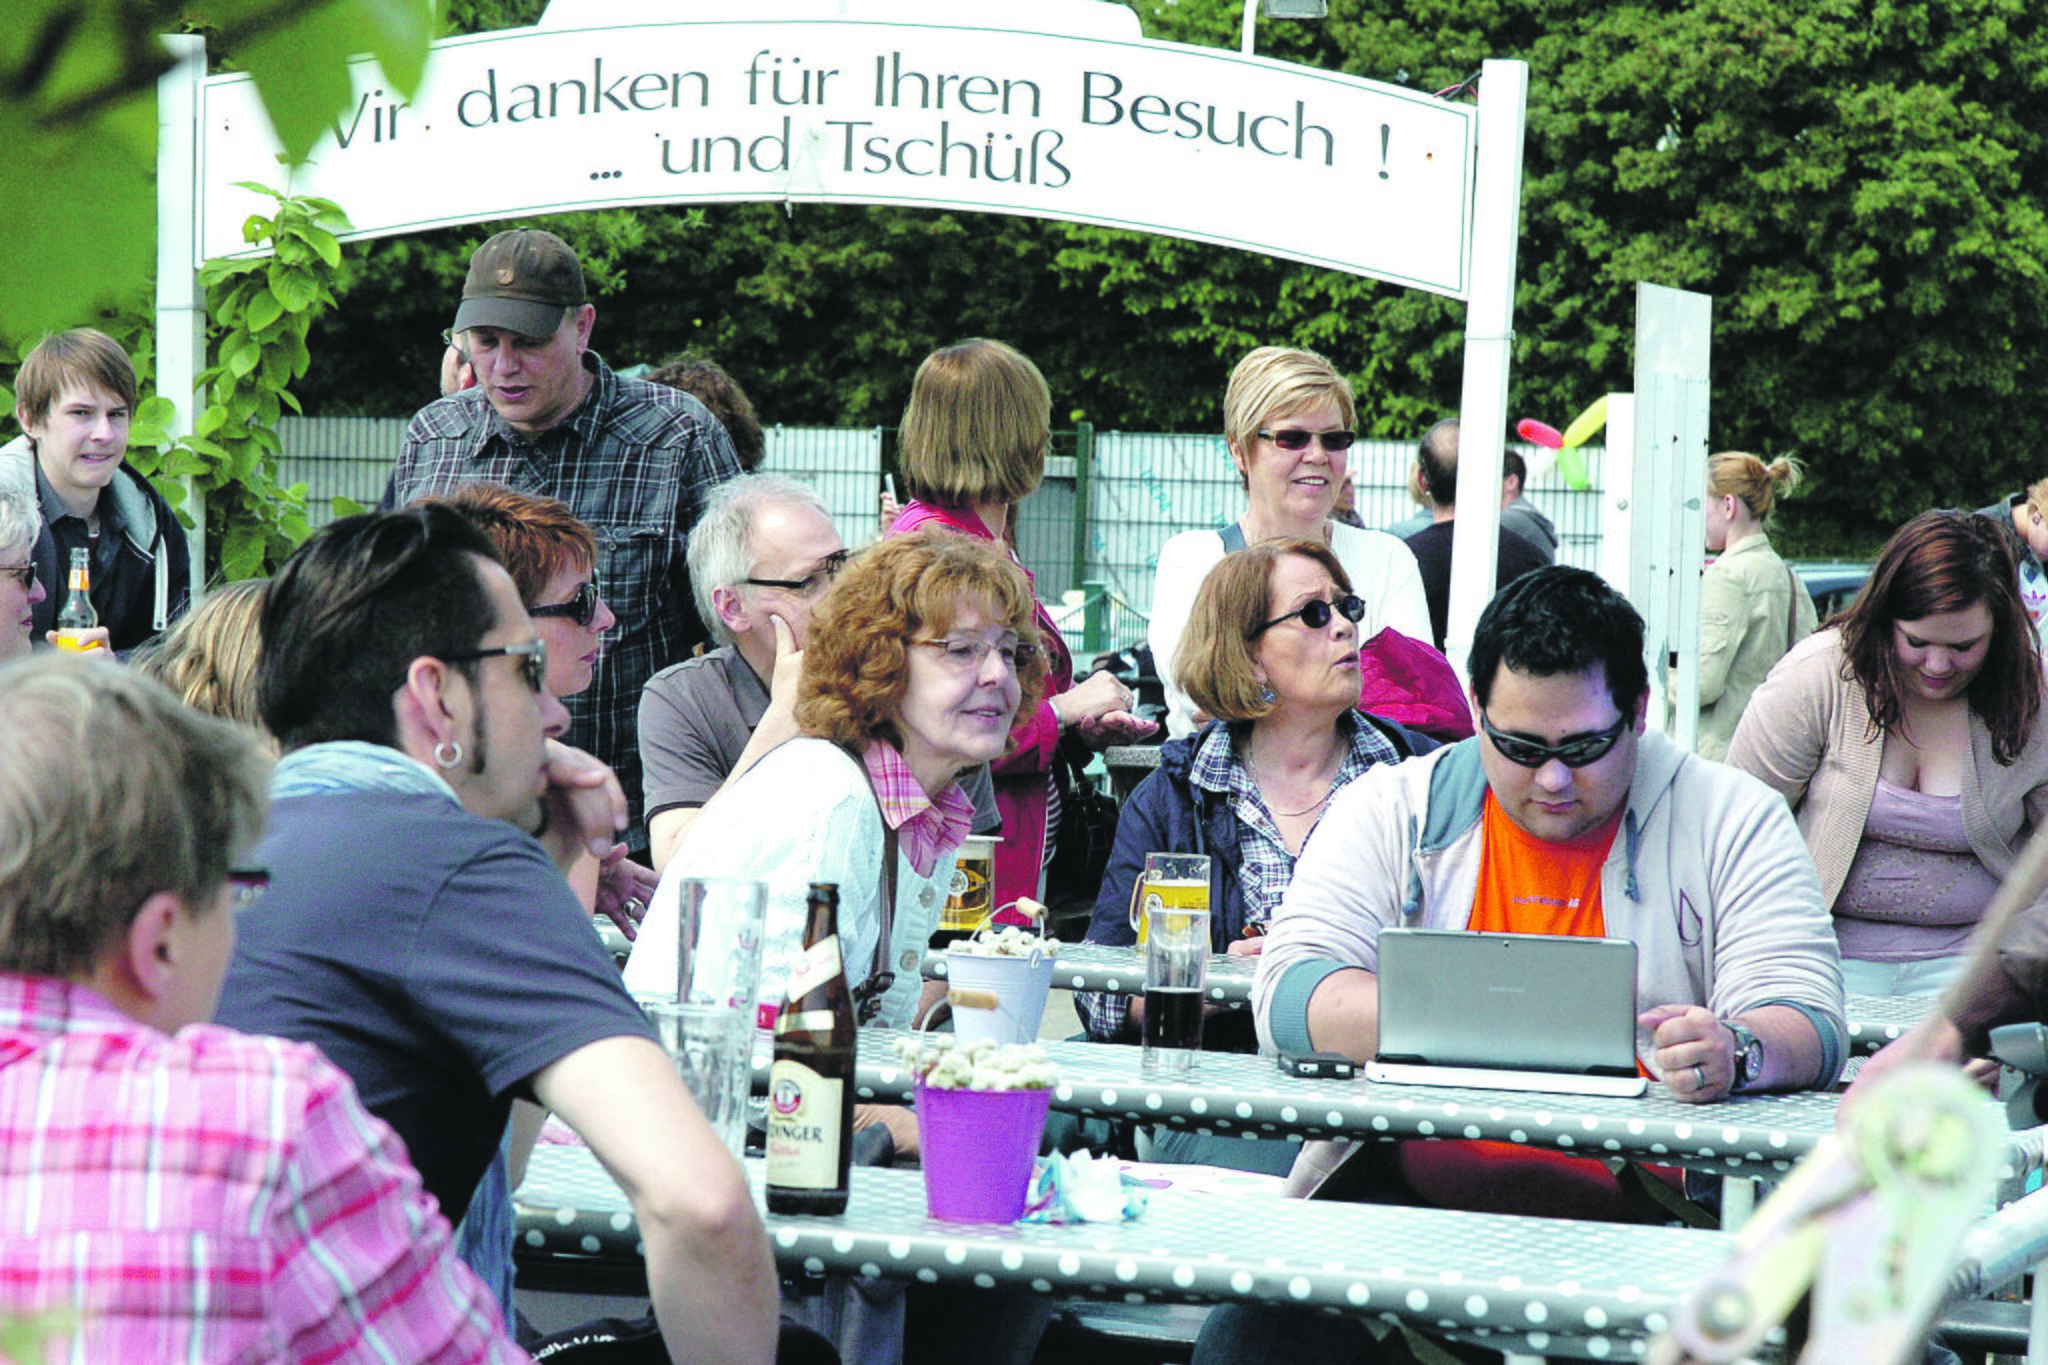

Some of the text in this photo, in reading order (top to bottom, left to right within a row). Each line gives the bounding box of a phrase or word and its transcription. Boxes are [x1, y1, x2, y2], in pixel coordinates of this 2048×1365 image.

[456, 57, 709, 128] danken
[744, 49, 839, 106] für
[875, 51, 1041, 118] Ihren
[1081, 71, 1334, 166] Besuch
[661, 115, 791, 175] und
[825, 120, 1071, 188] Tschüß
